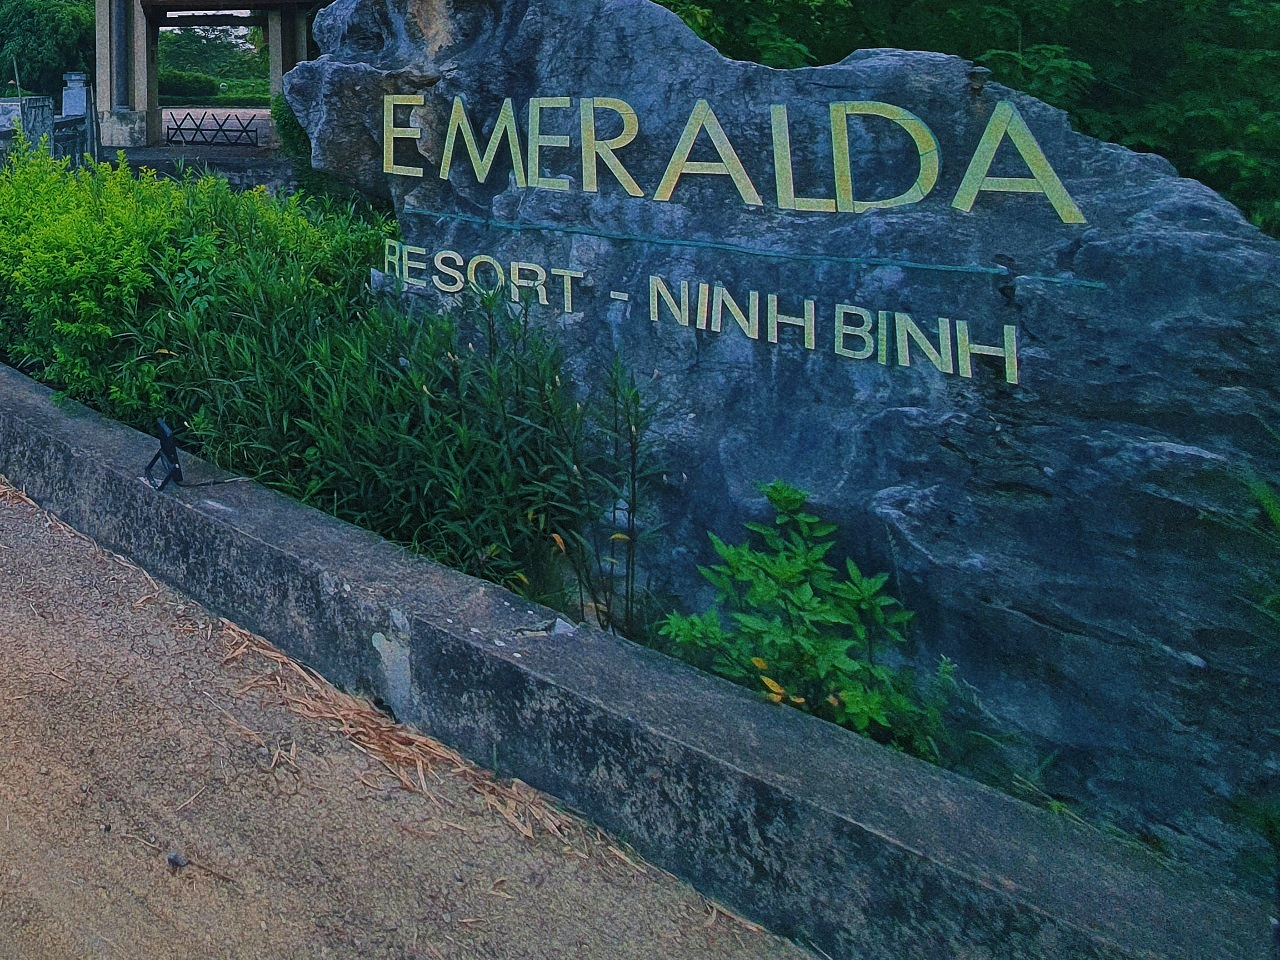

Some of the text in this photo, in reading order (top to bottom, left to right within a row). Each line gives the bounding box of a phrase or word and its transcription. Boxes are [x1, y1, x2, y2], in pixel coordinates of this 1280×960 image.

[382, 94, 1086, 224] EMERALDA
[384, 239, 584, 313] RESORT
[649, 275, 815, 349] NINH
[834, 304, 1018, 385] BINH
